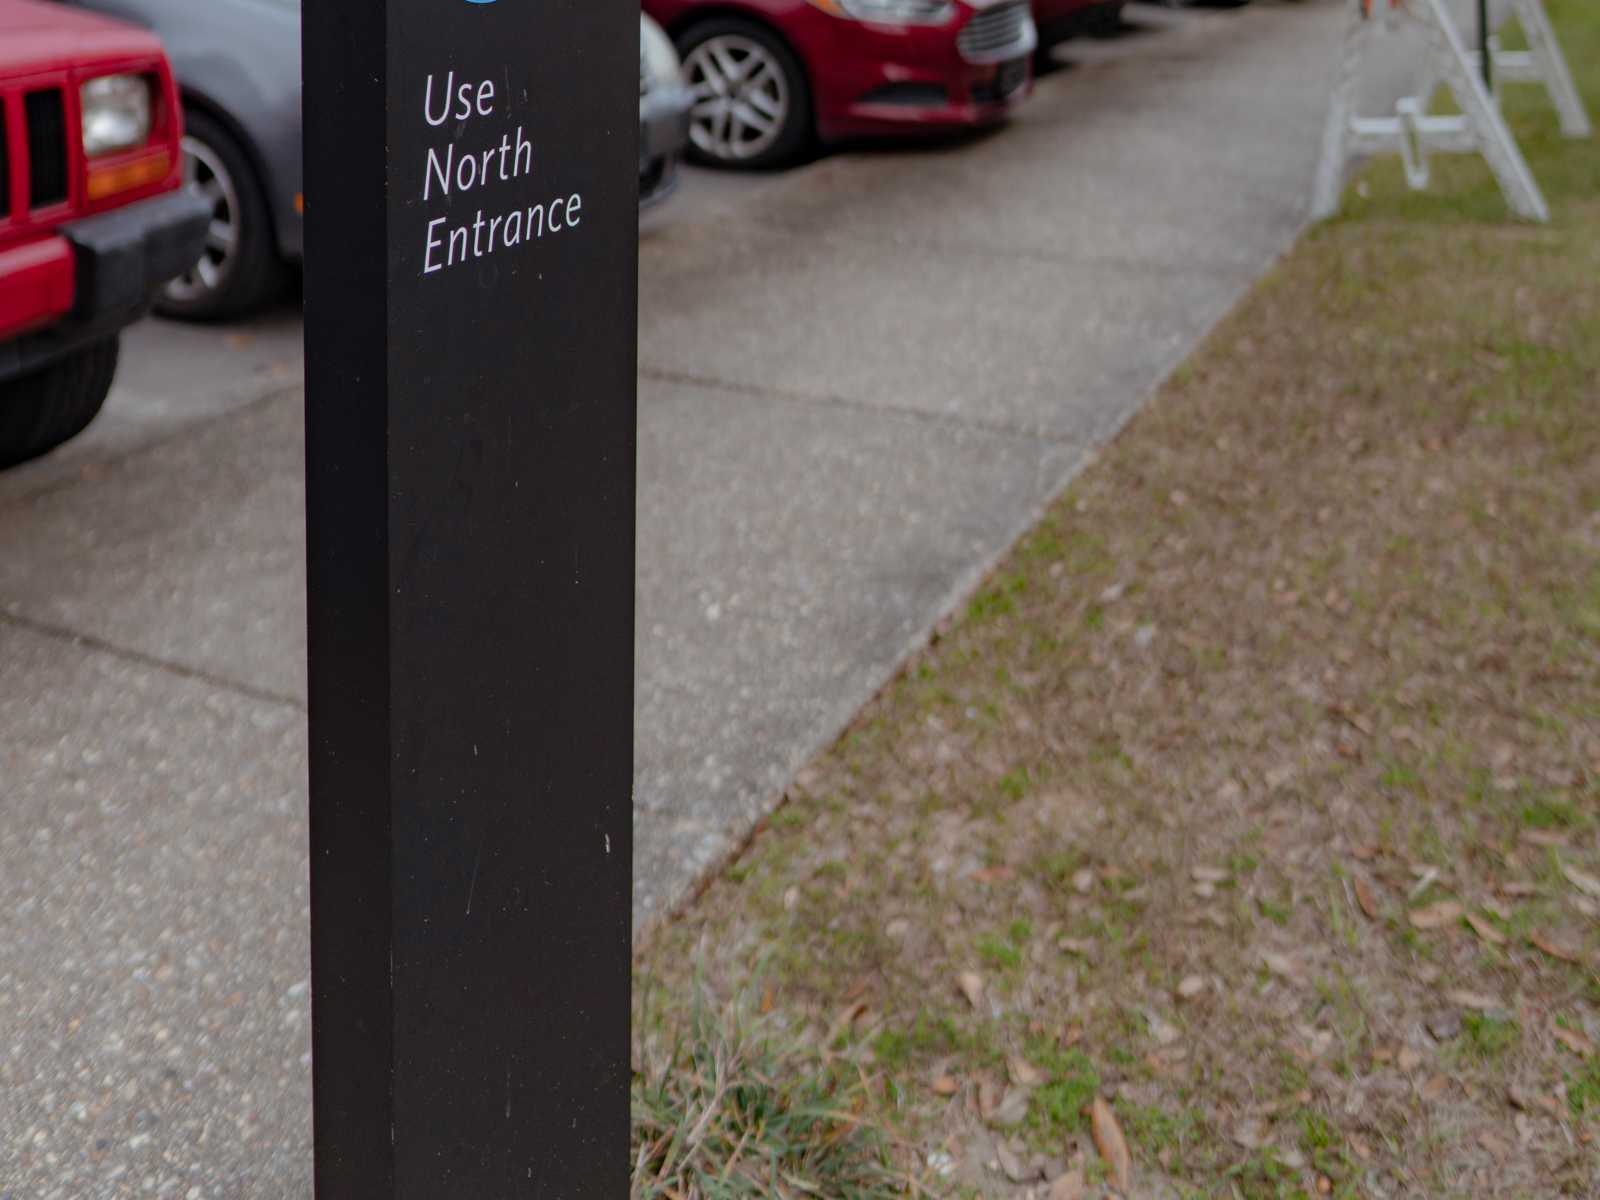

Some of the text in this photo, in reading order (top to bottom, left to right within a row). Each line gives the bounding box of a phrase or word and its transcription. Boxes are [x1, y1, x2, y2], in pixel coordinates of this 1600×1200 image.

[424, 71, 495, 126] Use
[423, 126, 532, 201] North
[423, 193, 582, 274] Entrance
